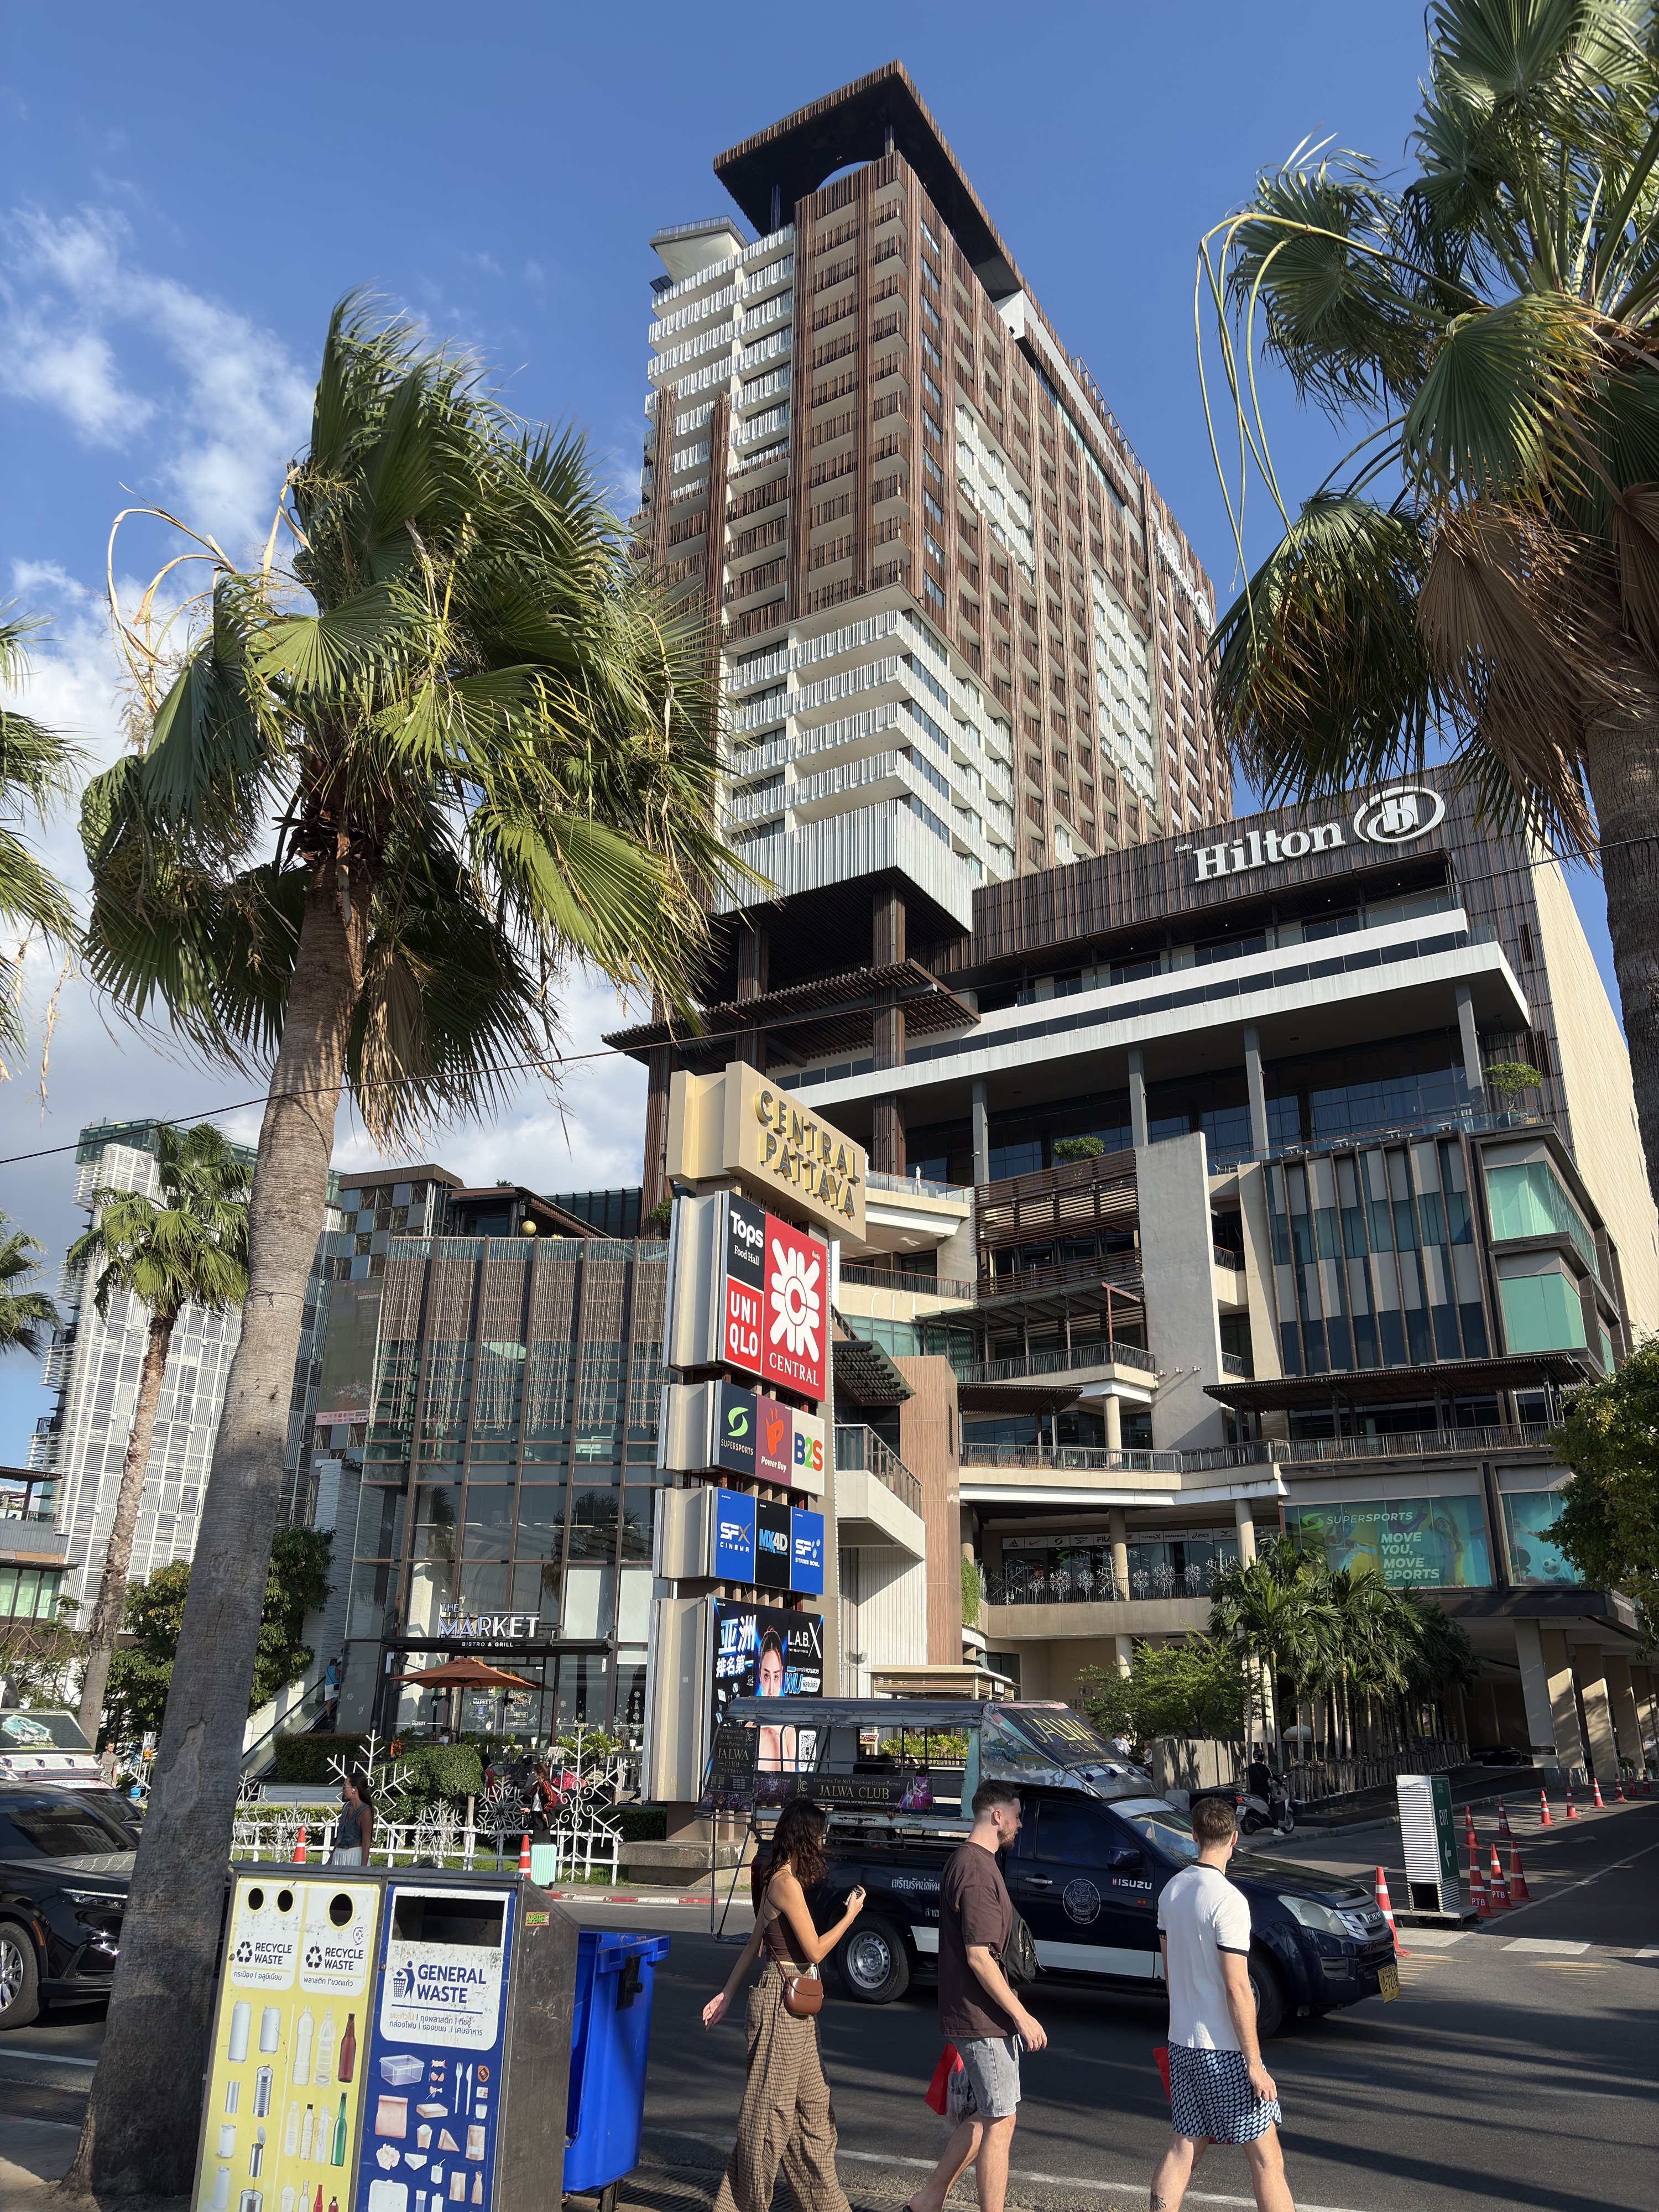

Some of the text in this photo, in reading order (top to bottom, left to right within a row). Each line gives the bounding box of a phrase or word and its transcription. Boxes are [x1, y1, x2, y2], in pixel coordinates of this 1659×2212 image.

[1193, 822, 1346, 883] Hilton
[755, 1090, 860, 1183] CENTRAL
[759, 1131, 855, 1217] PATTAYA
[730, 1209, 764, 1248] Tops
[734, 1244, 759, 1266] Food Hall
[731, 1290, 757, 1327] UNI
[729, 1322, 758, 1357] QLO
[769, 1352, 820, 1386] CENTRAL
[721, 1438, 754, 1456] SUPERSPORTS
[794, 1431, 823, 1472] B2S
[761, 1456, 787, 1473] Power Buy
[1327, 1512, 1413, 1525] SUPERSPORTS
[720, 1522, 752, 1545] SFX
[759, 1528, 788, 1554] MX4D
[1381, 1532, 1422, 1543] MOVE
[719, 1541, 749, 1553] CINEMA
[795, 1538, 812, 1556] SF
[1381, 1545, 1413, 1556] YOU,
[1383, 1557, 1425, 1568] MOVE
[1384, 1569, 1439, 1580] SPORTS
[441, 1603, 460, 1613] THE
[437, 1616, 540, 1638] MARKET
[718, 1614, 757, 1656] 亚洲
[716, 1654, 754, 1678] 排名第一
[1022, 1718, 1105, 1744] JALWA
[717, 1748, 749, 1760] JALWA
[1068, 1743, 1103, 1752] CLUB
[819, 1785, 890, 1799] JALWA CLUB
[1439, 1808, 1448, 1826] EXIT
[1118, 1879, 1152, 1890] ISUZU
[1471, 1897, 1485, 1906] PTB
[255, 1942, 293, 1954] RECYCLE
[325, 1947, 364, 1959] RECYCLE
[254, 1954, 283, 1965] WASTE
[325, 1959, 354, 1970] WASTE
[233, 1970, 282, 1982] กระป๋อง อลูมิเนียม
[304, 1976, 353, 1987] พลาสติก ขวดแก้ว
[418, 1964, 487, 1985] GENERAL
[417, 1984, 468, 2004] WASTE
[389, 2020, 483, 2036] กล่องโฟม ซองขนม เศษอาหาร
[420, 2014, 453, 2025] ถุงพลาสติก
